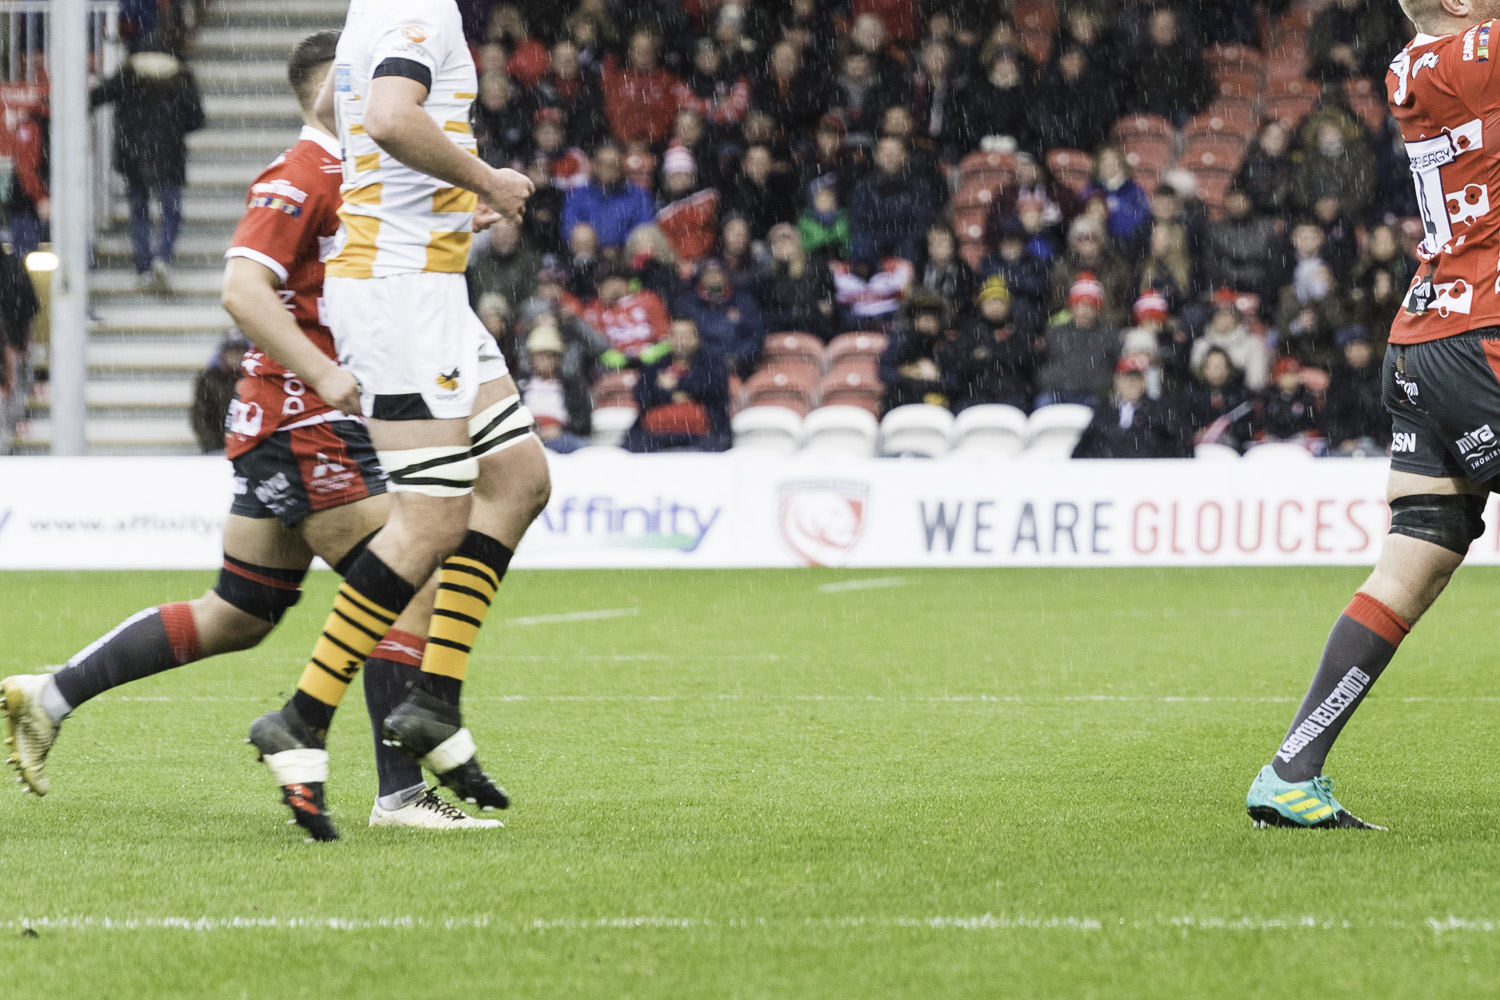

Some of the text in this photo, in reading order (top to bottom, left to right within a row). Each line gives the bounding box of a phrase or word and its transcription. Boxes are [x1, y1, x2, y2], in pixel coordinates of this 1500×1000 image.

[1455, 424, 1495, 455] mira
[920, 500, 996, 554] WE
[1012, 500, 1113, 555] ARE
[1307, 665, 1371, 727] GLOUCESTER
[1276, 718, 1325, 763] RUGBY
